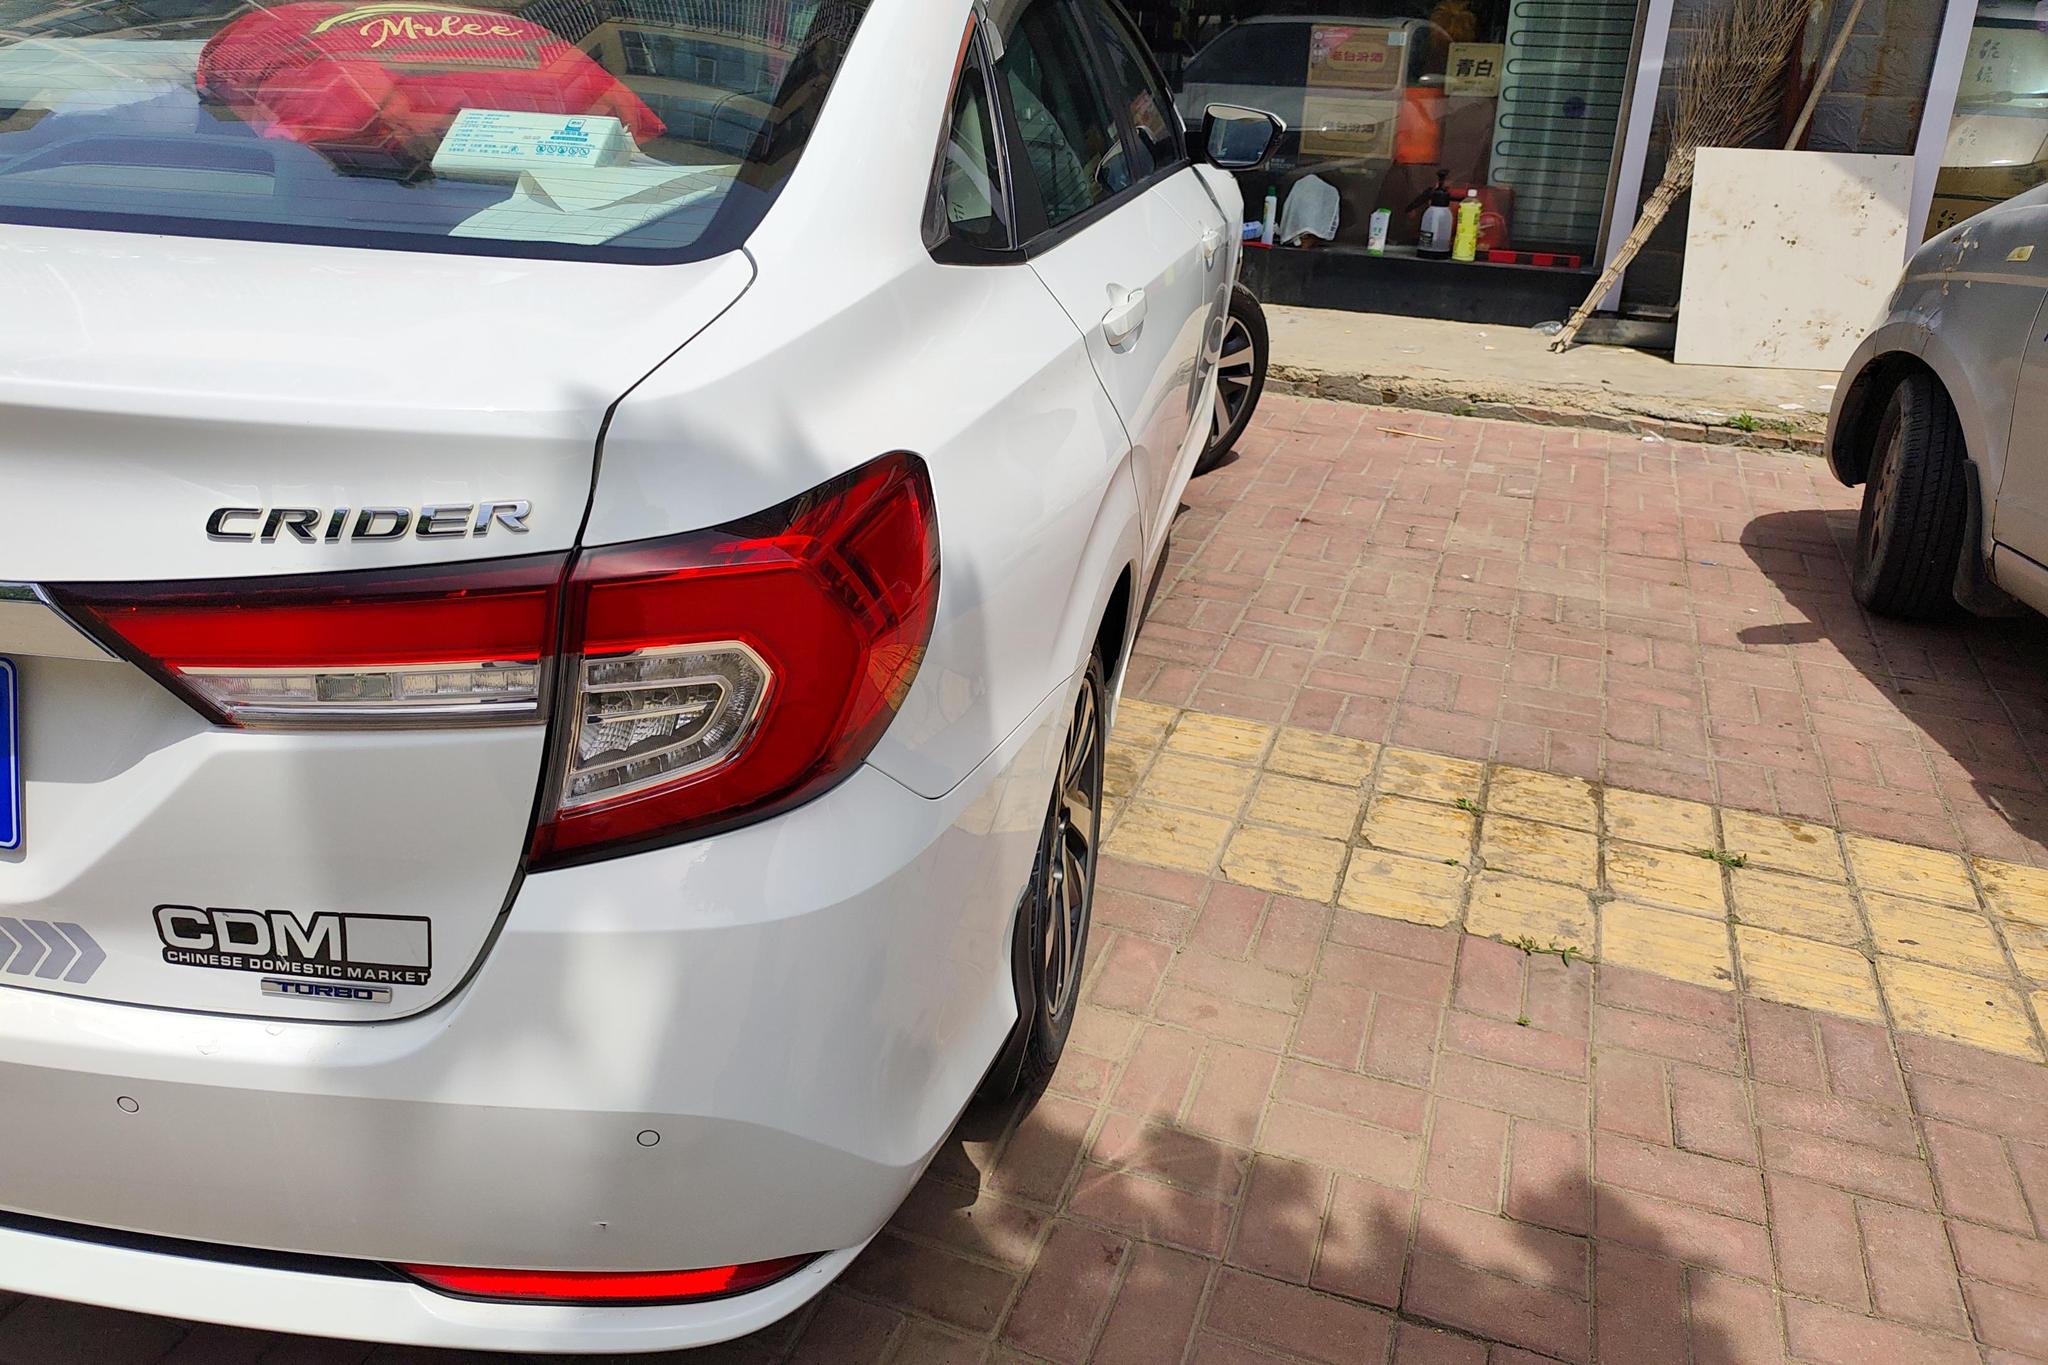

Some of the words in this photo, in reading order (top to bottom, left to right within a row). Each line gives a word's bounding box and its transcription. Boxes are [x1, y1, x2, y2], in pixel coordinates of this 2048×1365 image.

[206, 499, 533, 544] CRIDER
[157, 906, 342, 962] CDM
[166, 950, 243, 968] CHINESE
[249, 958, 342, 978] DOMESTIC
[346, 967, 430, 984] MARKET
[277, 983, 374, 1001] TURBO
